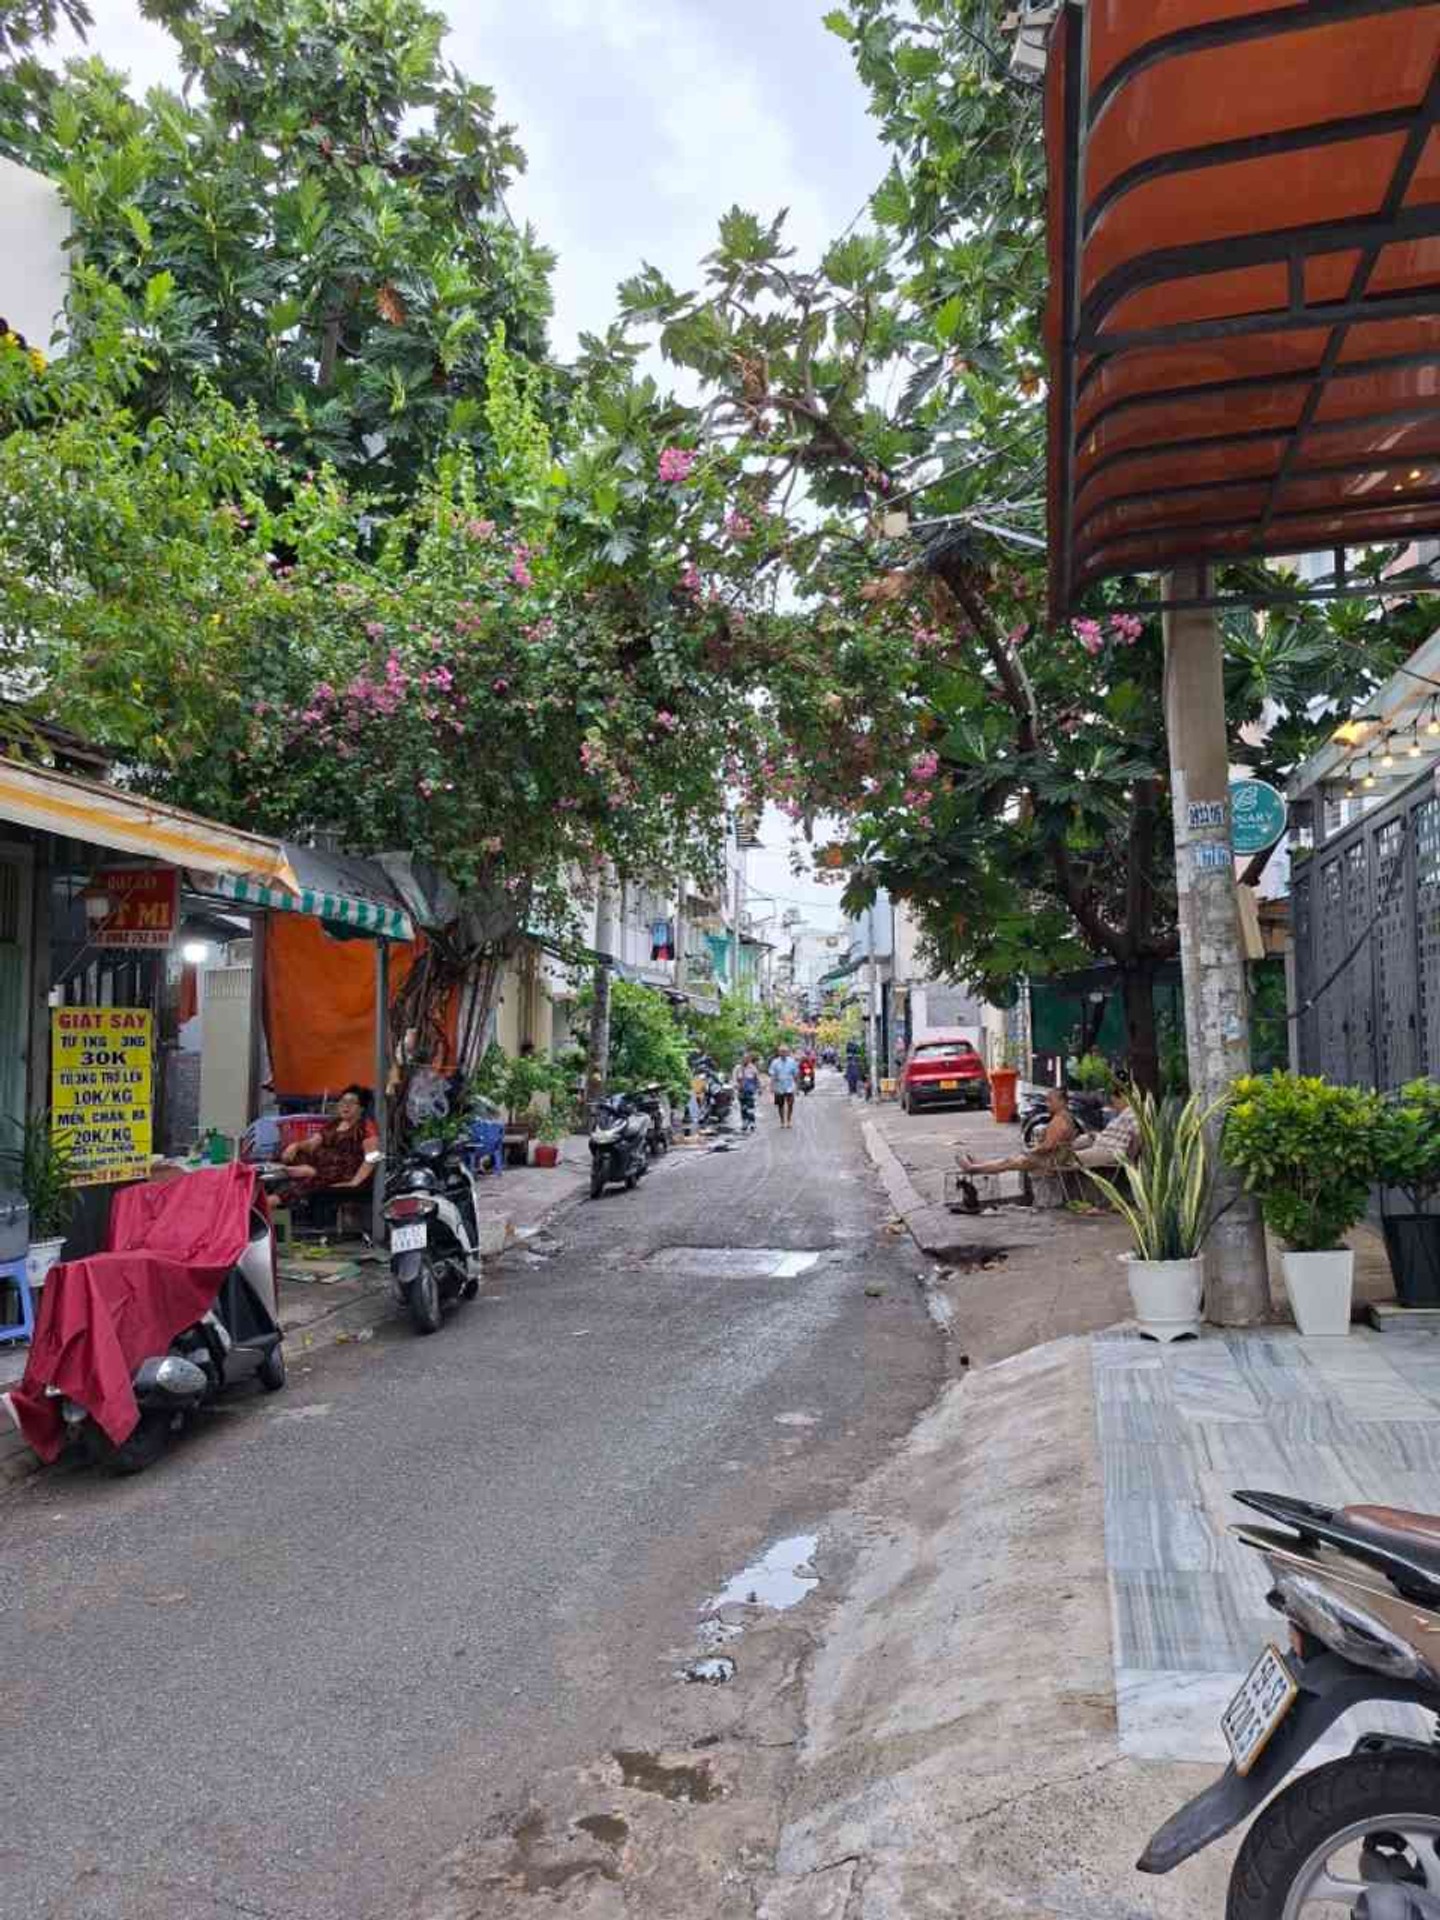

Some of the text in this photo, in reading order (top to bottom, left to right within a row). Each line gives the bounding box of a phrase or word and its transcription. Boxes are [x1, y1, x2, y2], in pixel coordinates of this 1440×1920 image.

[80, 1050, 127, 1066] 30K
[74, 1087, 133, 1105] 10K/KG
[74, 1126, 132, 1145] 20K/KG
